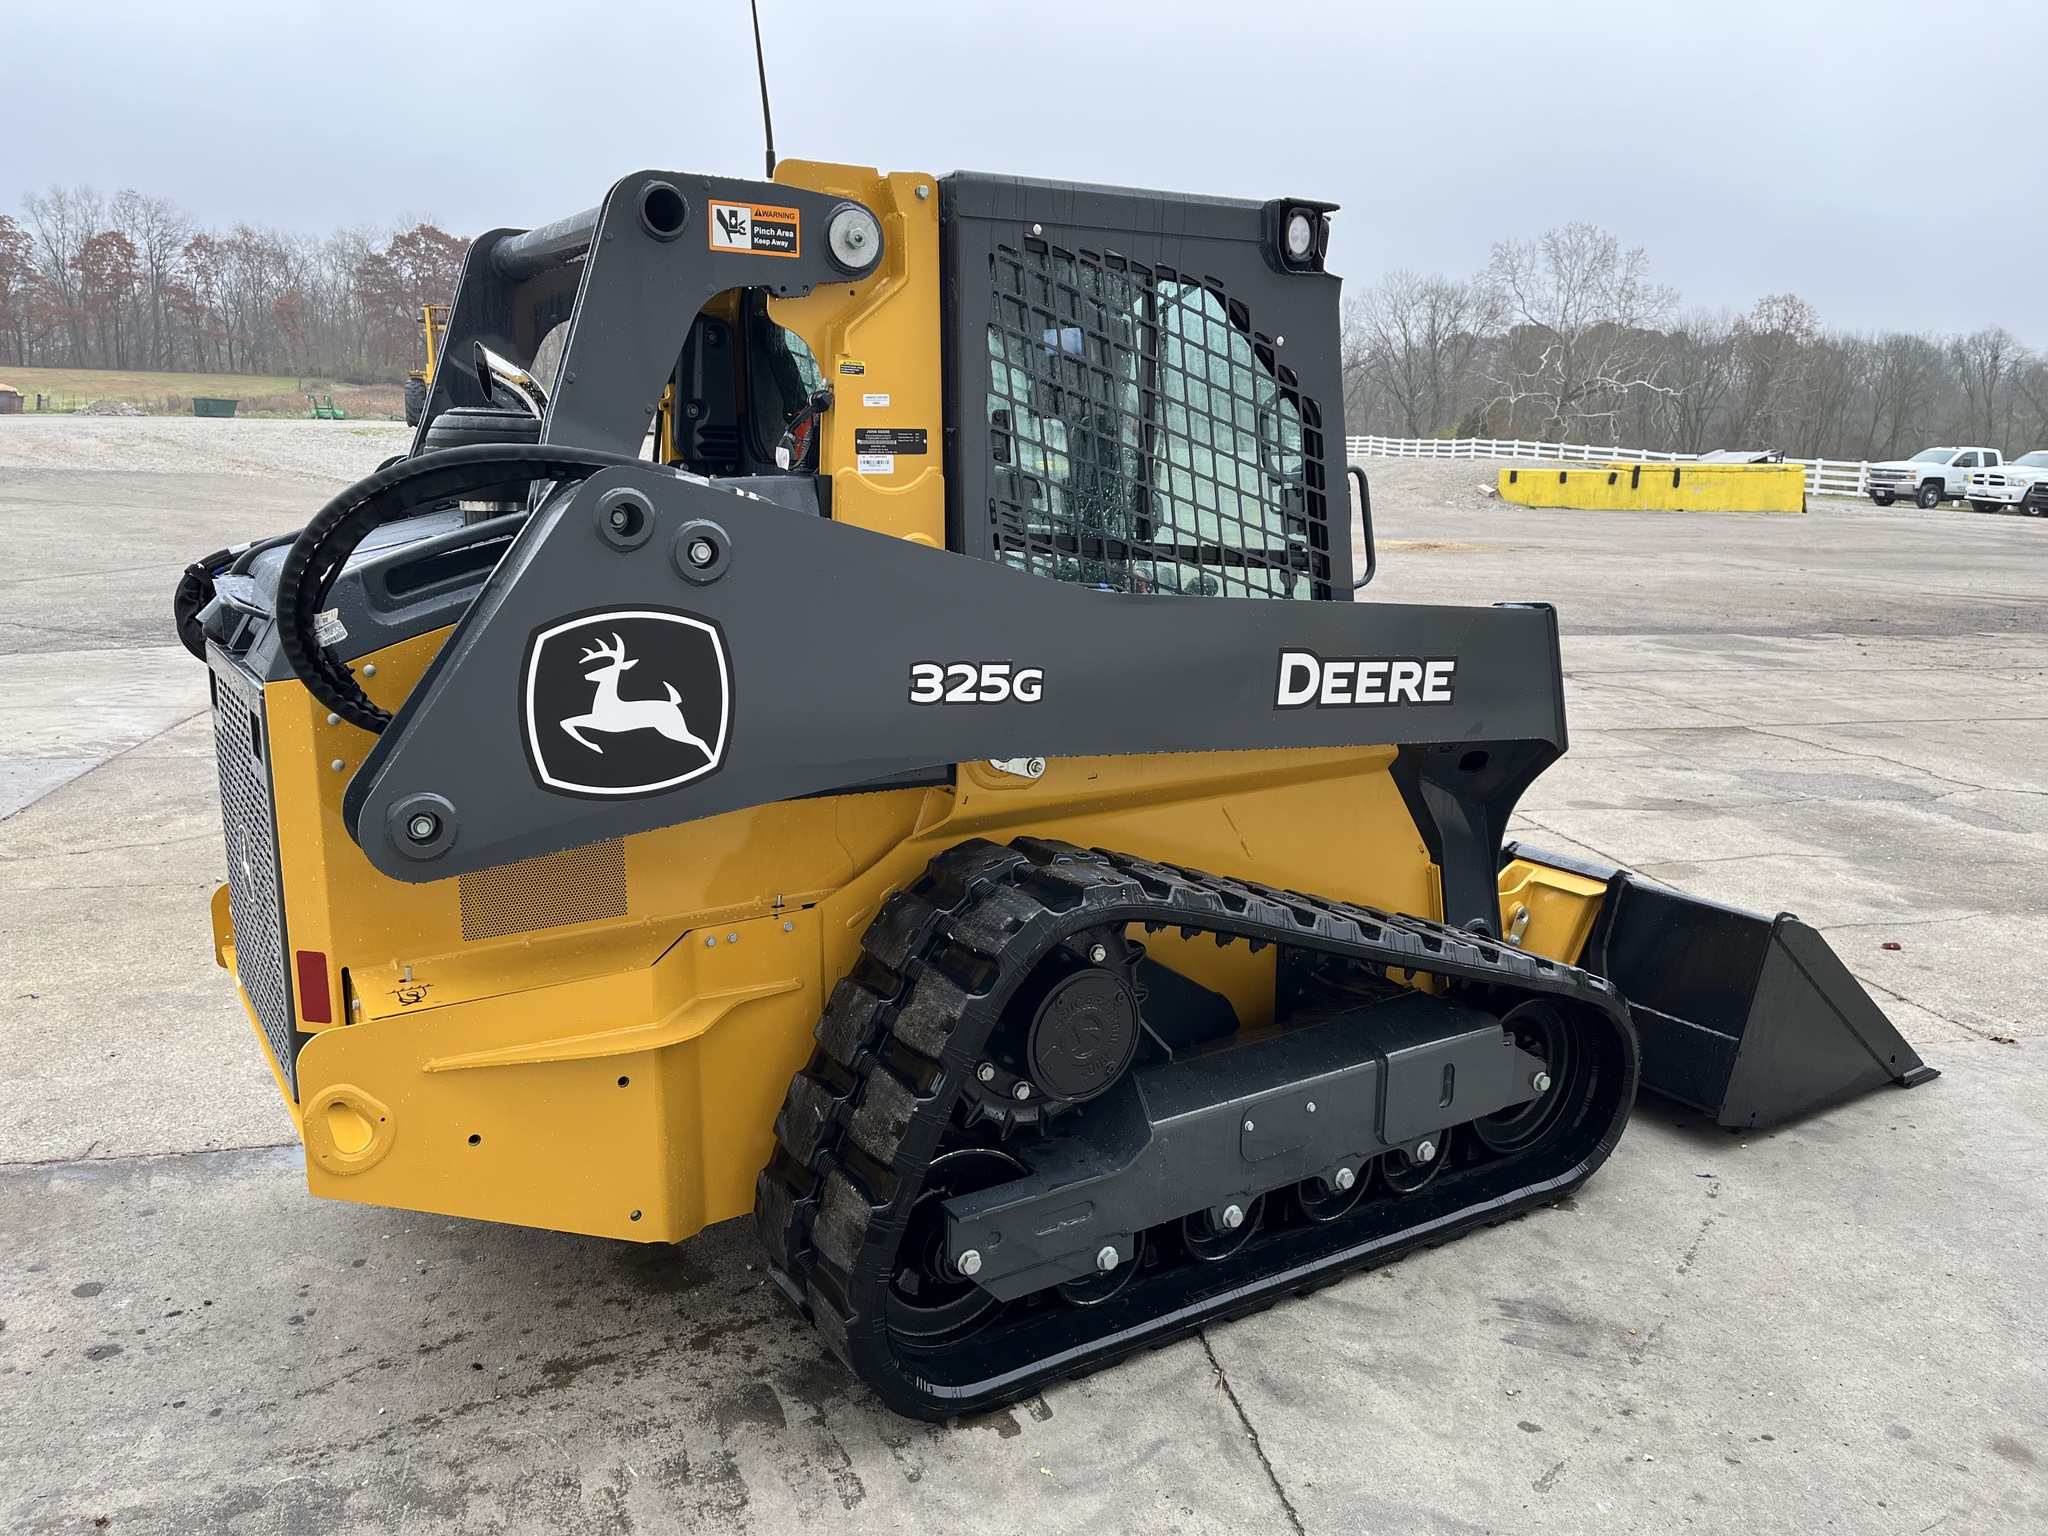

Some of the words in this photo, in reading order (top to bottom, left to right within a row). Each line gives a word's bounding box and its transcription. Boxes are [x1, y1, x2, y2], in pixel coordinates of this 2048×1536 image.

[762, 209, 795, 220] WARNING
[754, 226, 775, 236] Pinch
[776, 229, 794, 238] Area
[754, 236, 771, 246] Keep
[771, 238, 789, 248] Away
[909, 662, 1043, 703] 325G
[1277, 652, 1456, 706] DEERE
